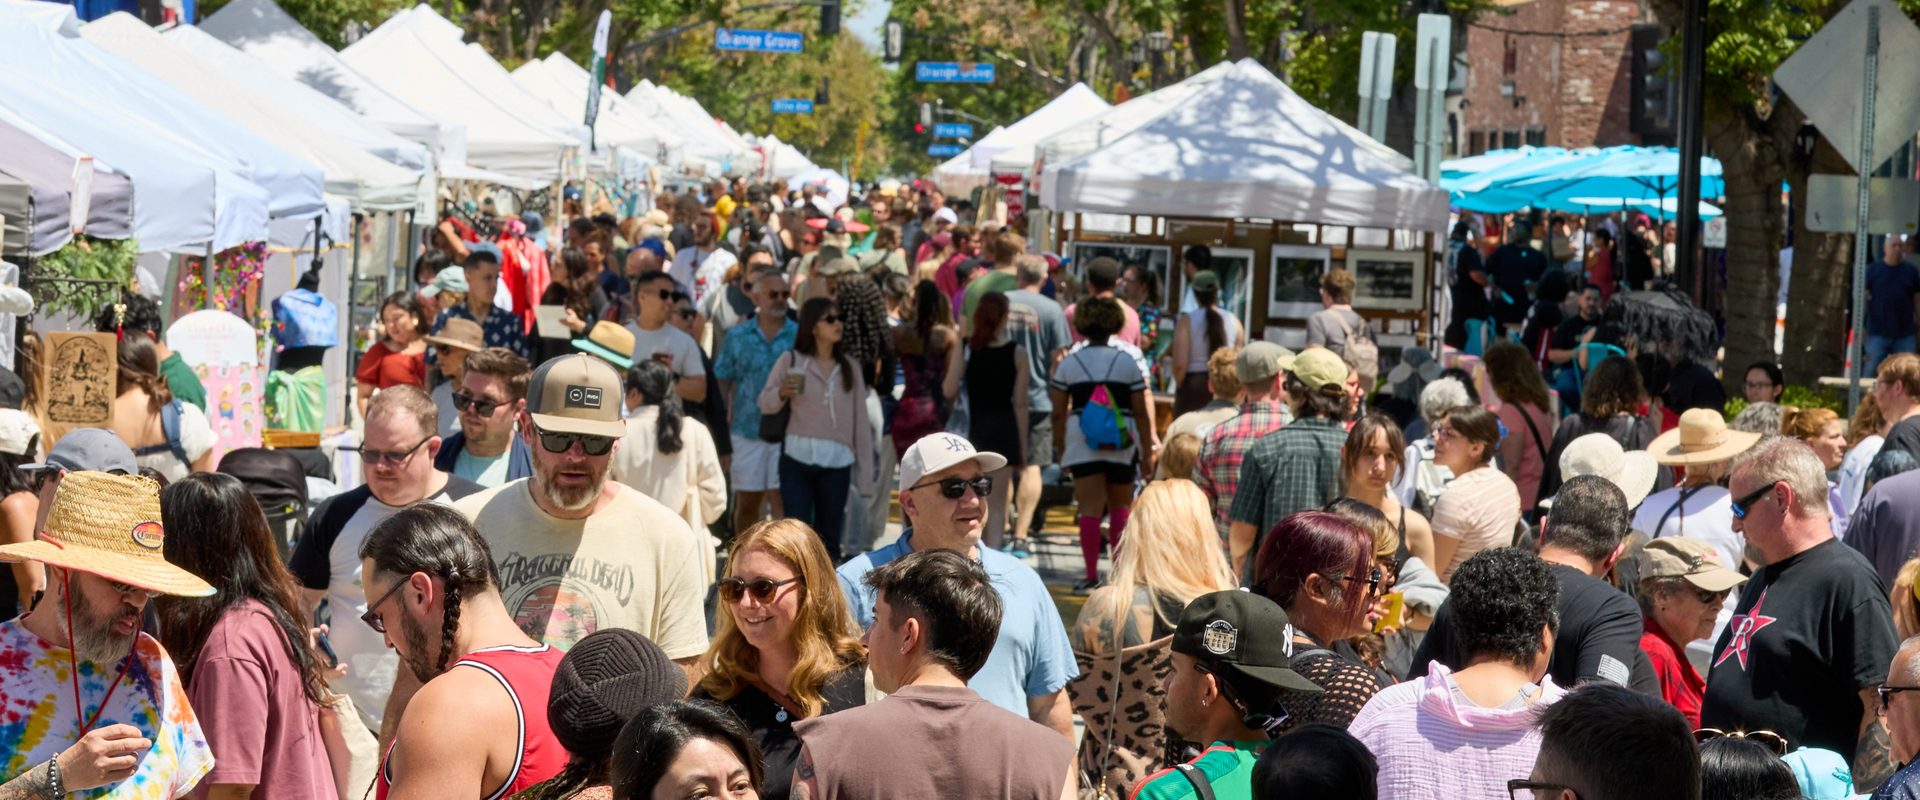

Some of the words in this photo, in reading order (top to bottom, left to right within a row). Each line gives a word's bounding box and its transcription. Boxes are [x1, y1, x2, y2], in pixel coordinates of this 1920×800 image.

[719, 29, 762, 50] Orange
[765, 33, 800, 49] Grove
[918, 65, 957, 80] Orange
[941, 437, 969, 452] LA
[589, 558, 634, 608] DEAD
[1730, 617, 1755, 650] R
